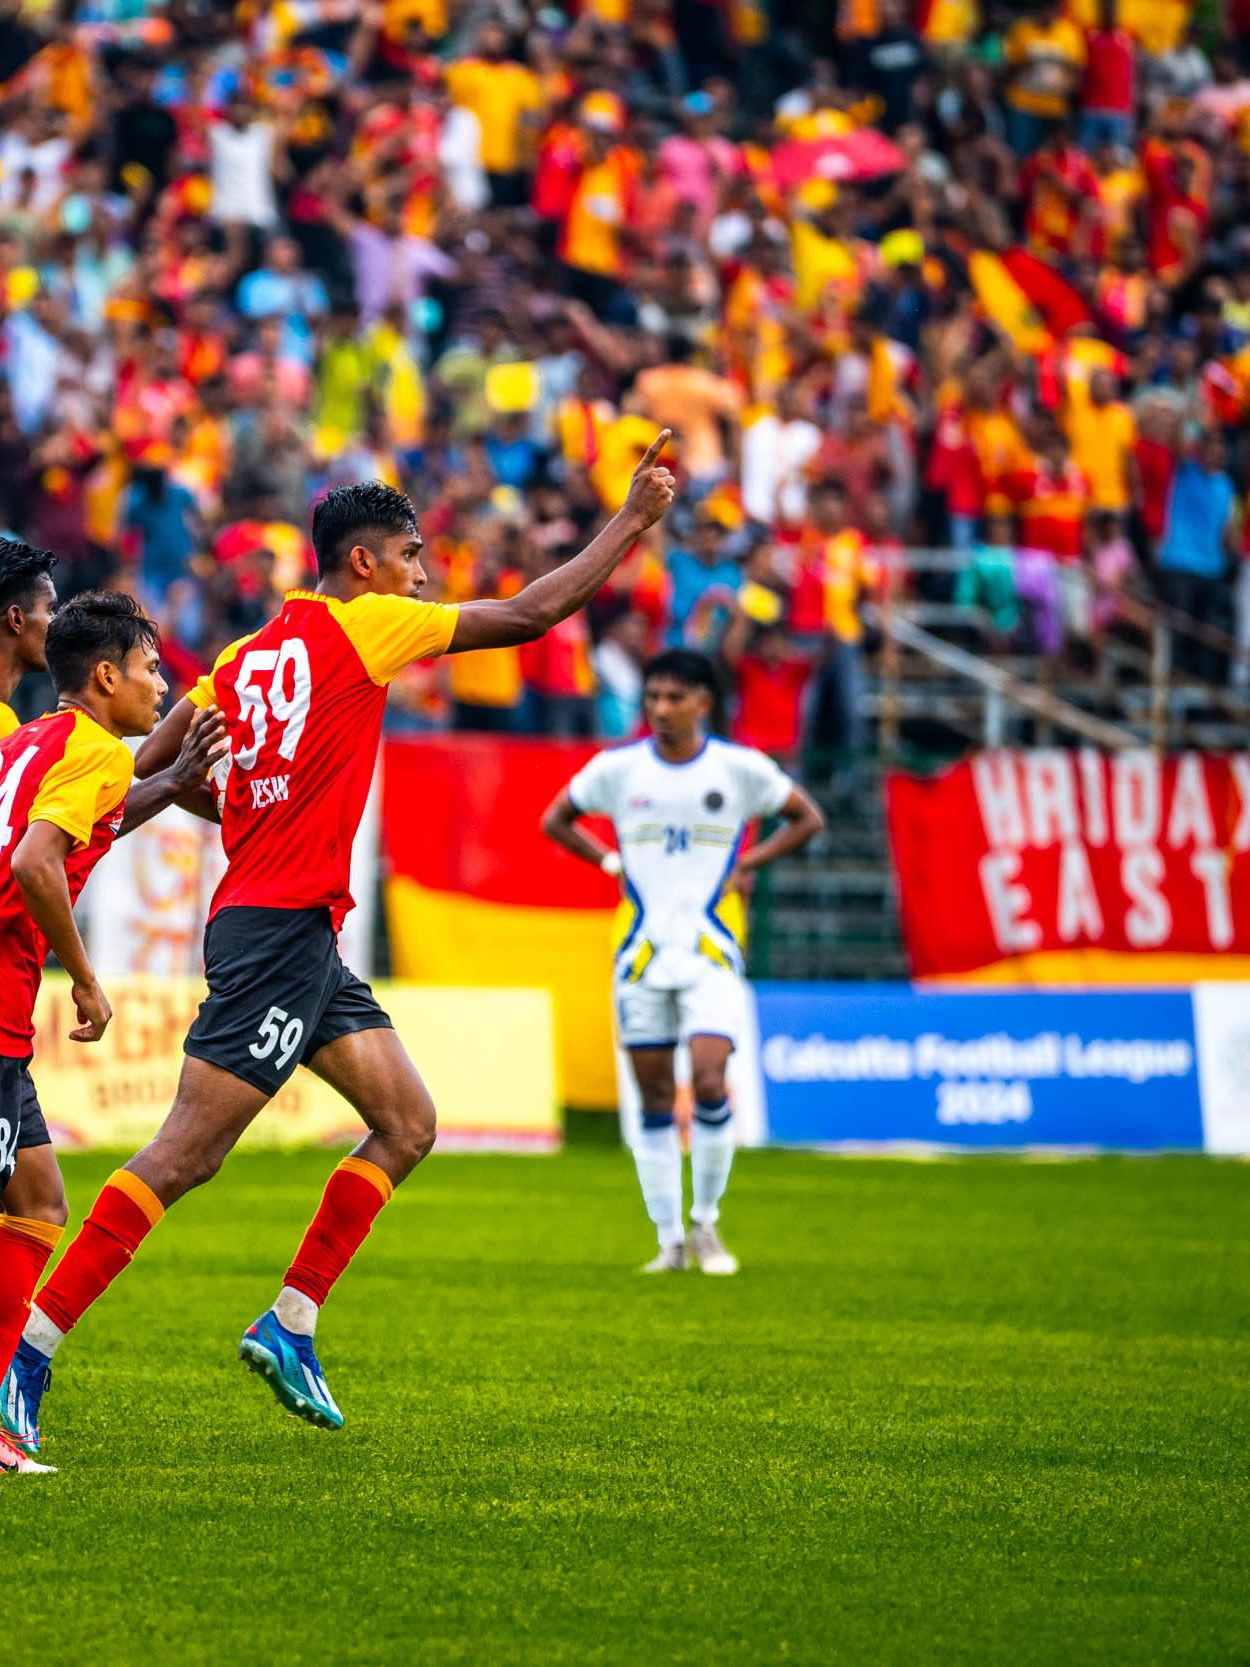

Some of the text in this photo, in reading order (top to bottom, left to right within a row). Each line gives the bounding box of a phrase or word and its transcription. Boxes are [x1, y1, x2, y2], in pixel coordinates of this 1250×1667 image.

[234, 637, 312, 771] 59
[978, 850, 1235, 952] EAST
[249, 1006, 304, 1071] 59
[763, 1031, 1192, 1084] Calcutta Football League
[936, 1078, 1032, 1126] 2024
